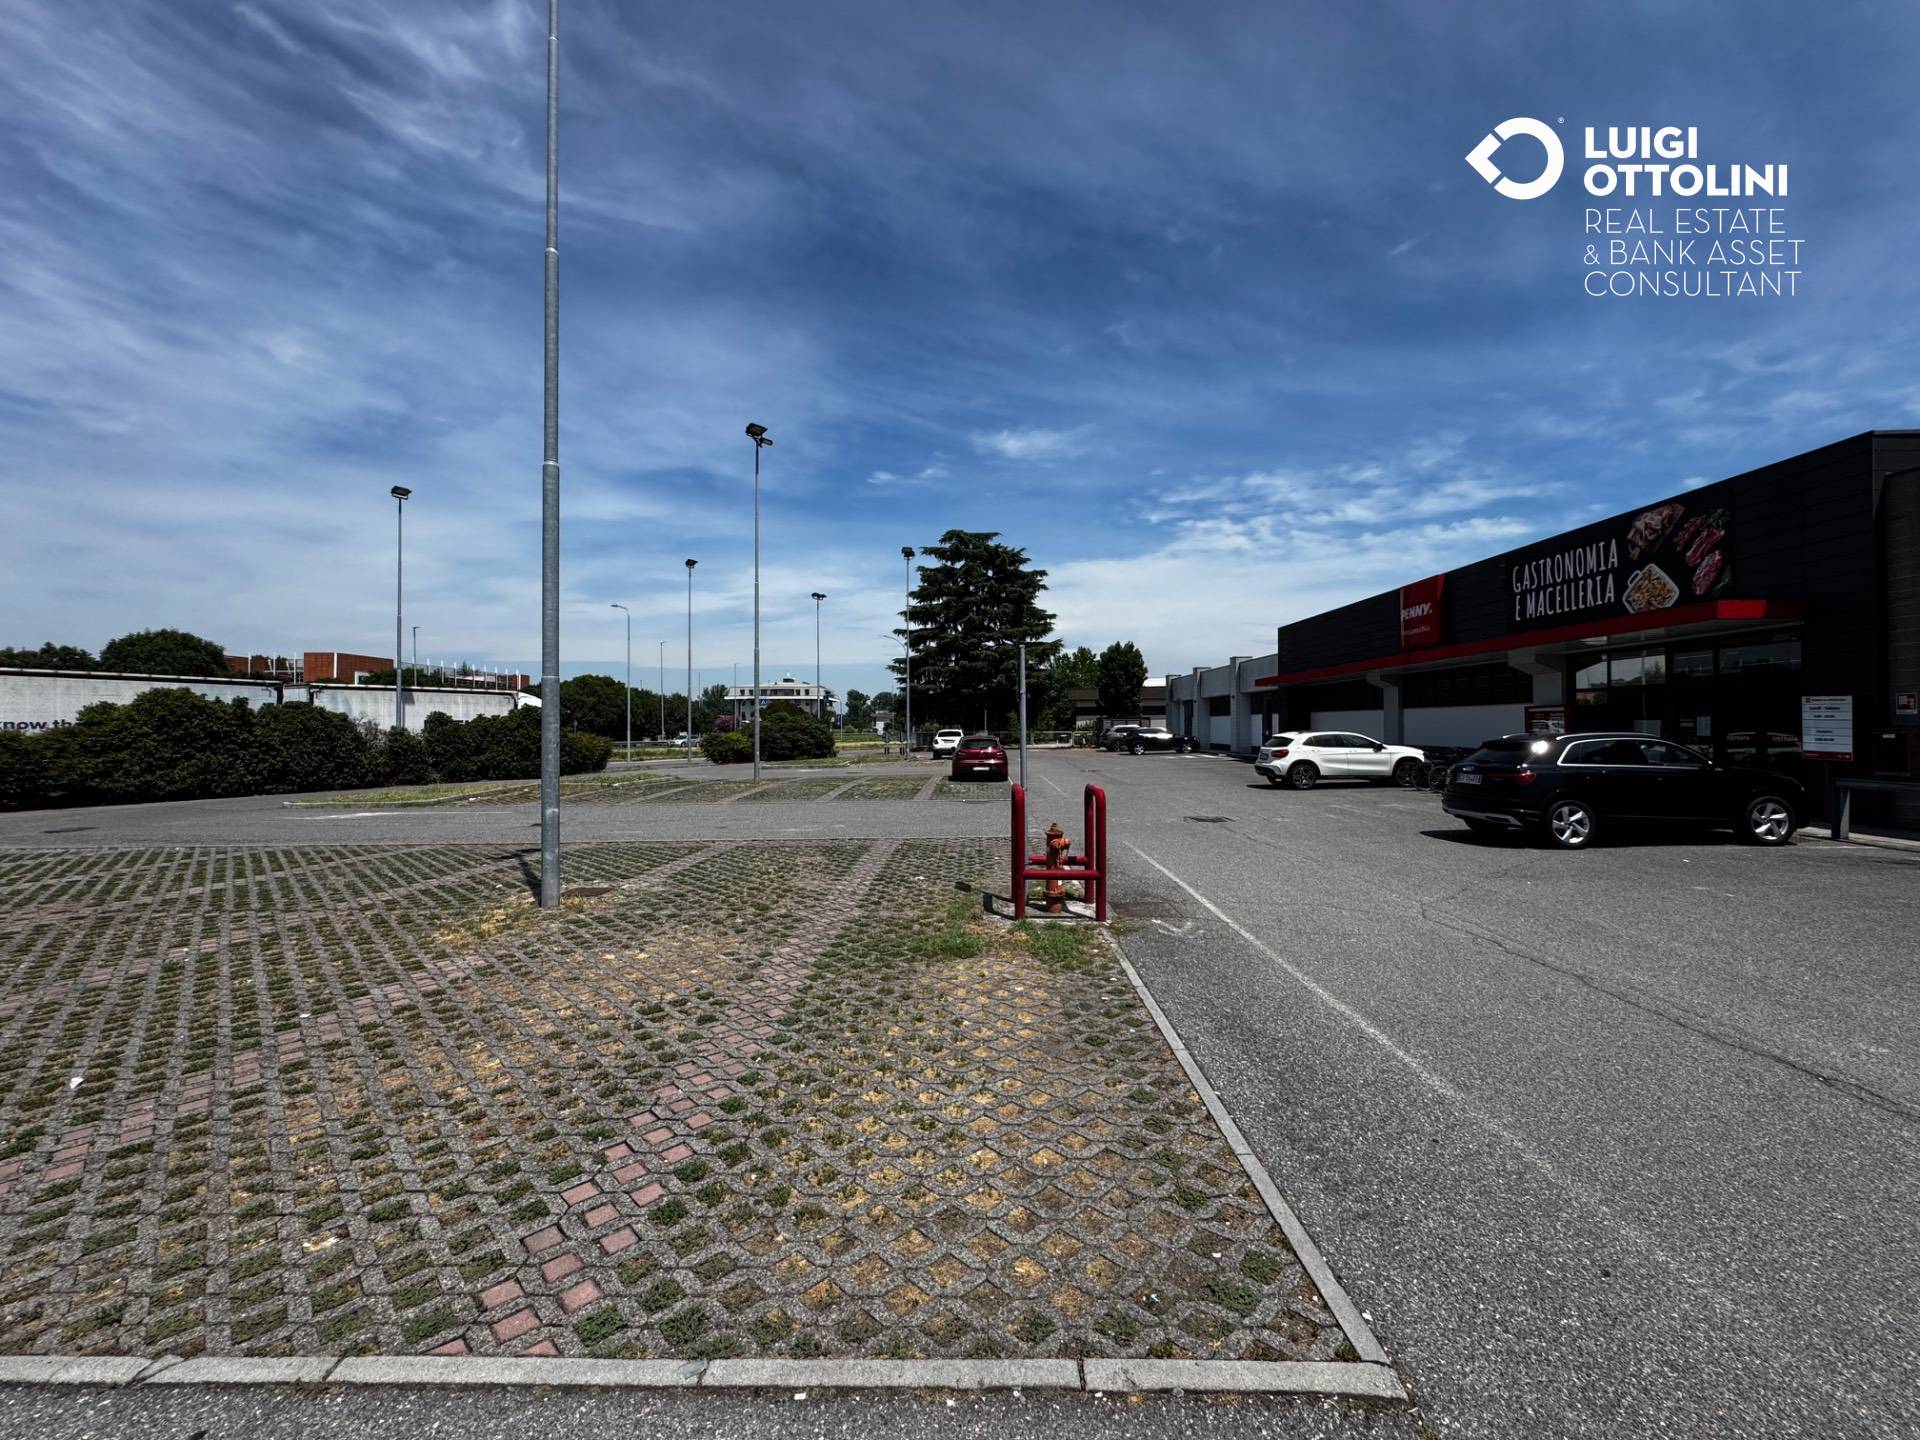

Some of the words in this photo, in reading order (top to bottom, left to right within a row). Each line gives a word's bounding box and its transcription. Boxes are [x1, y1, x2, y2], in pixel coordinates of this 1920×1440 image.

[1512, 538, 1618, 593] GASTRONOMIA
[1515, 595, 1521, 621] E
[1526, 572, 1615, 619] MACELLERIA
[0, 720, 47, 730] now
